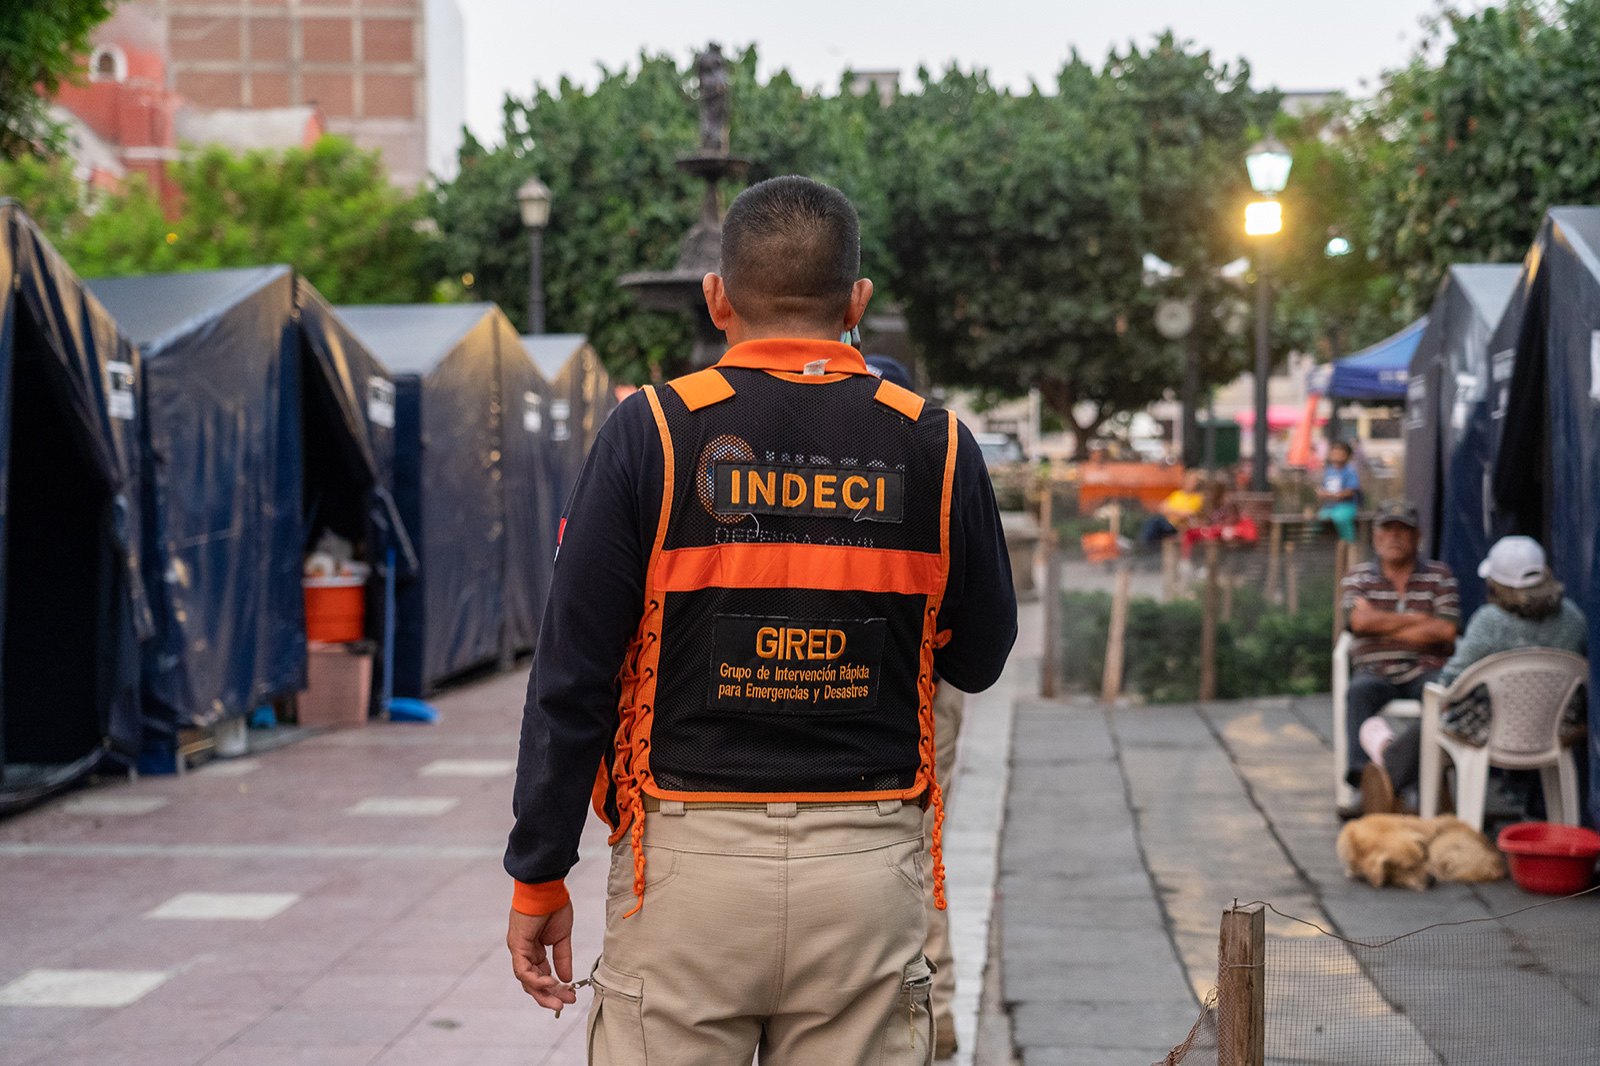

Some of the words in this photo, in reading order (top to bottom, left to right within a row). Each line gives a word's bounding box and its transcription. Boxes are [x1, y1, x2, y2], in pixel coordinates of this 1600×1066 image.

[731, 469, 885, 512] INDECI
[756, 626, 847, 660] GIRED
[720, 662, 752, 681] Grupo
[757, 665, 770, 680] de
[775, 664, 836, 681] Intervención
[839, 663, 870, 683] Rápida
[718, 683, 741, 699] para
[746, 682, 809, 702] Emergencias
[813, 688, 820, 703] y
[824, 684, 869, 700] Desastres
